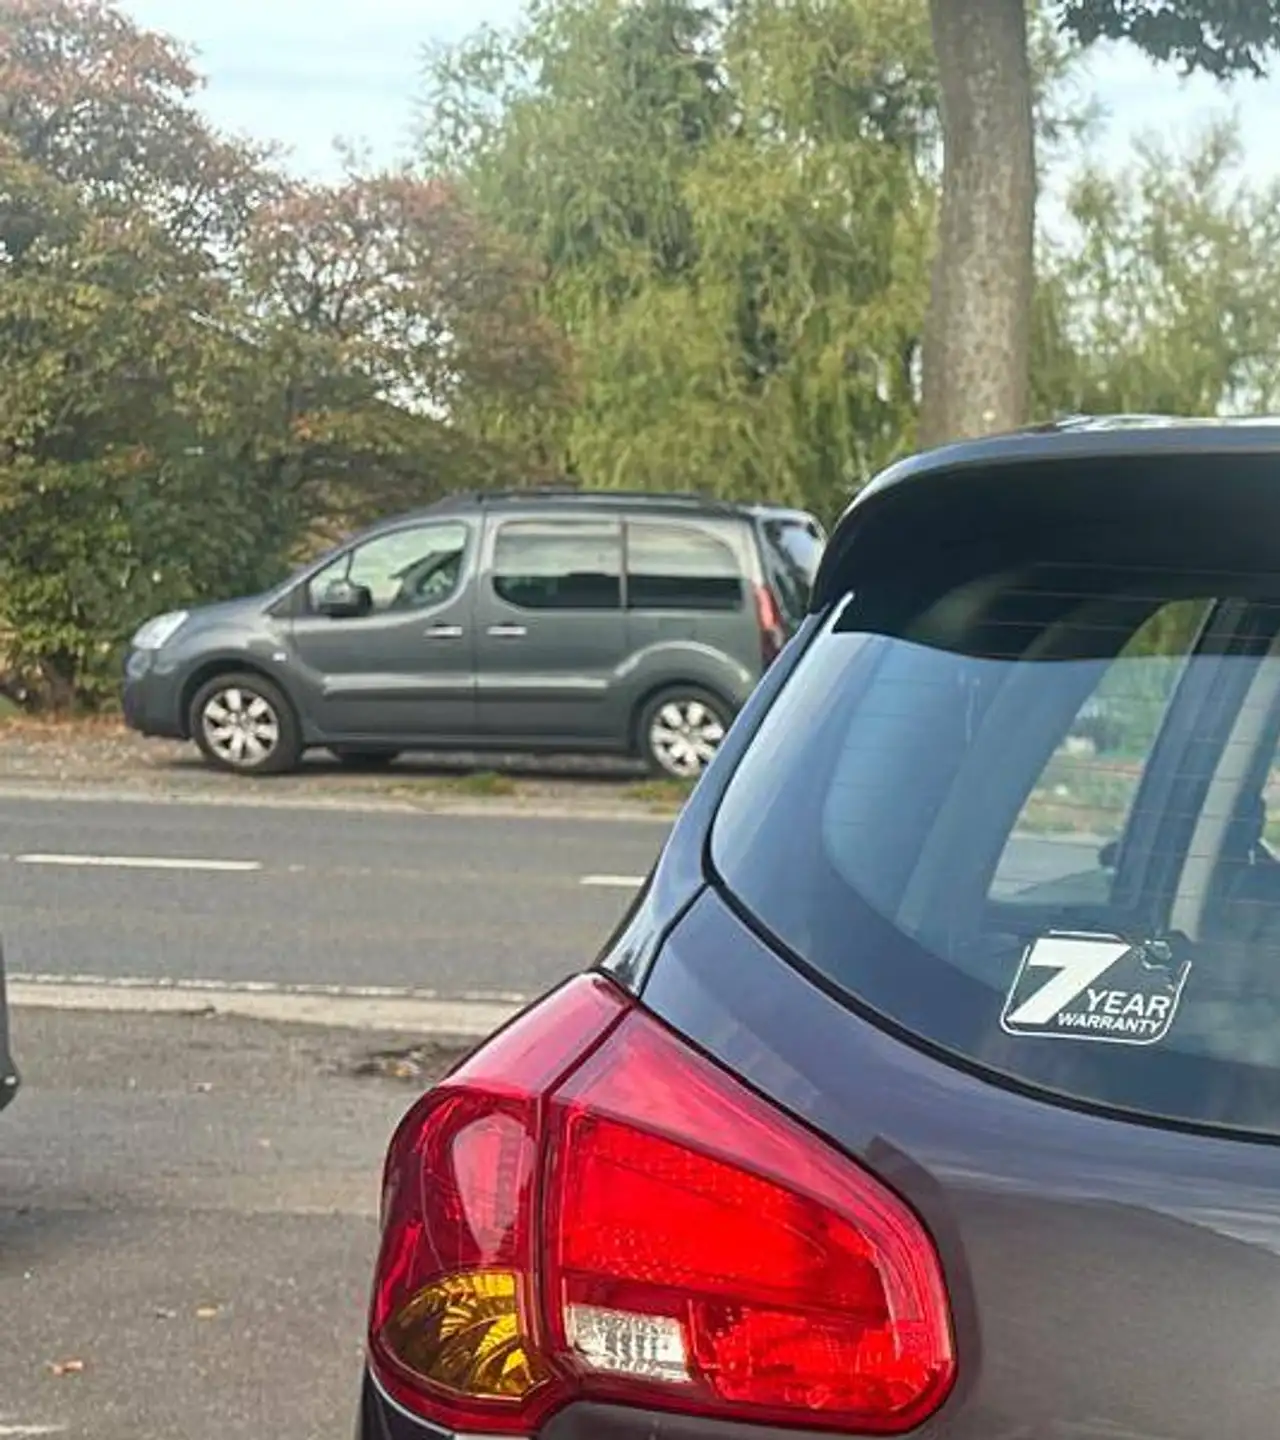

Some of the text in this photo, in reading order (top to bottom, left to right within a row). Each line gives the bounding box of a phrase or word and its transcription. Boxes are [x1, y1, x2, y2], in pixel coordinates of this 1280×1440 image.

[1006, 938, 1170, 1024] 7 YEAR
[1057, 1013, 1165, 1033] WARRANTY
